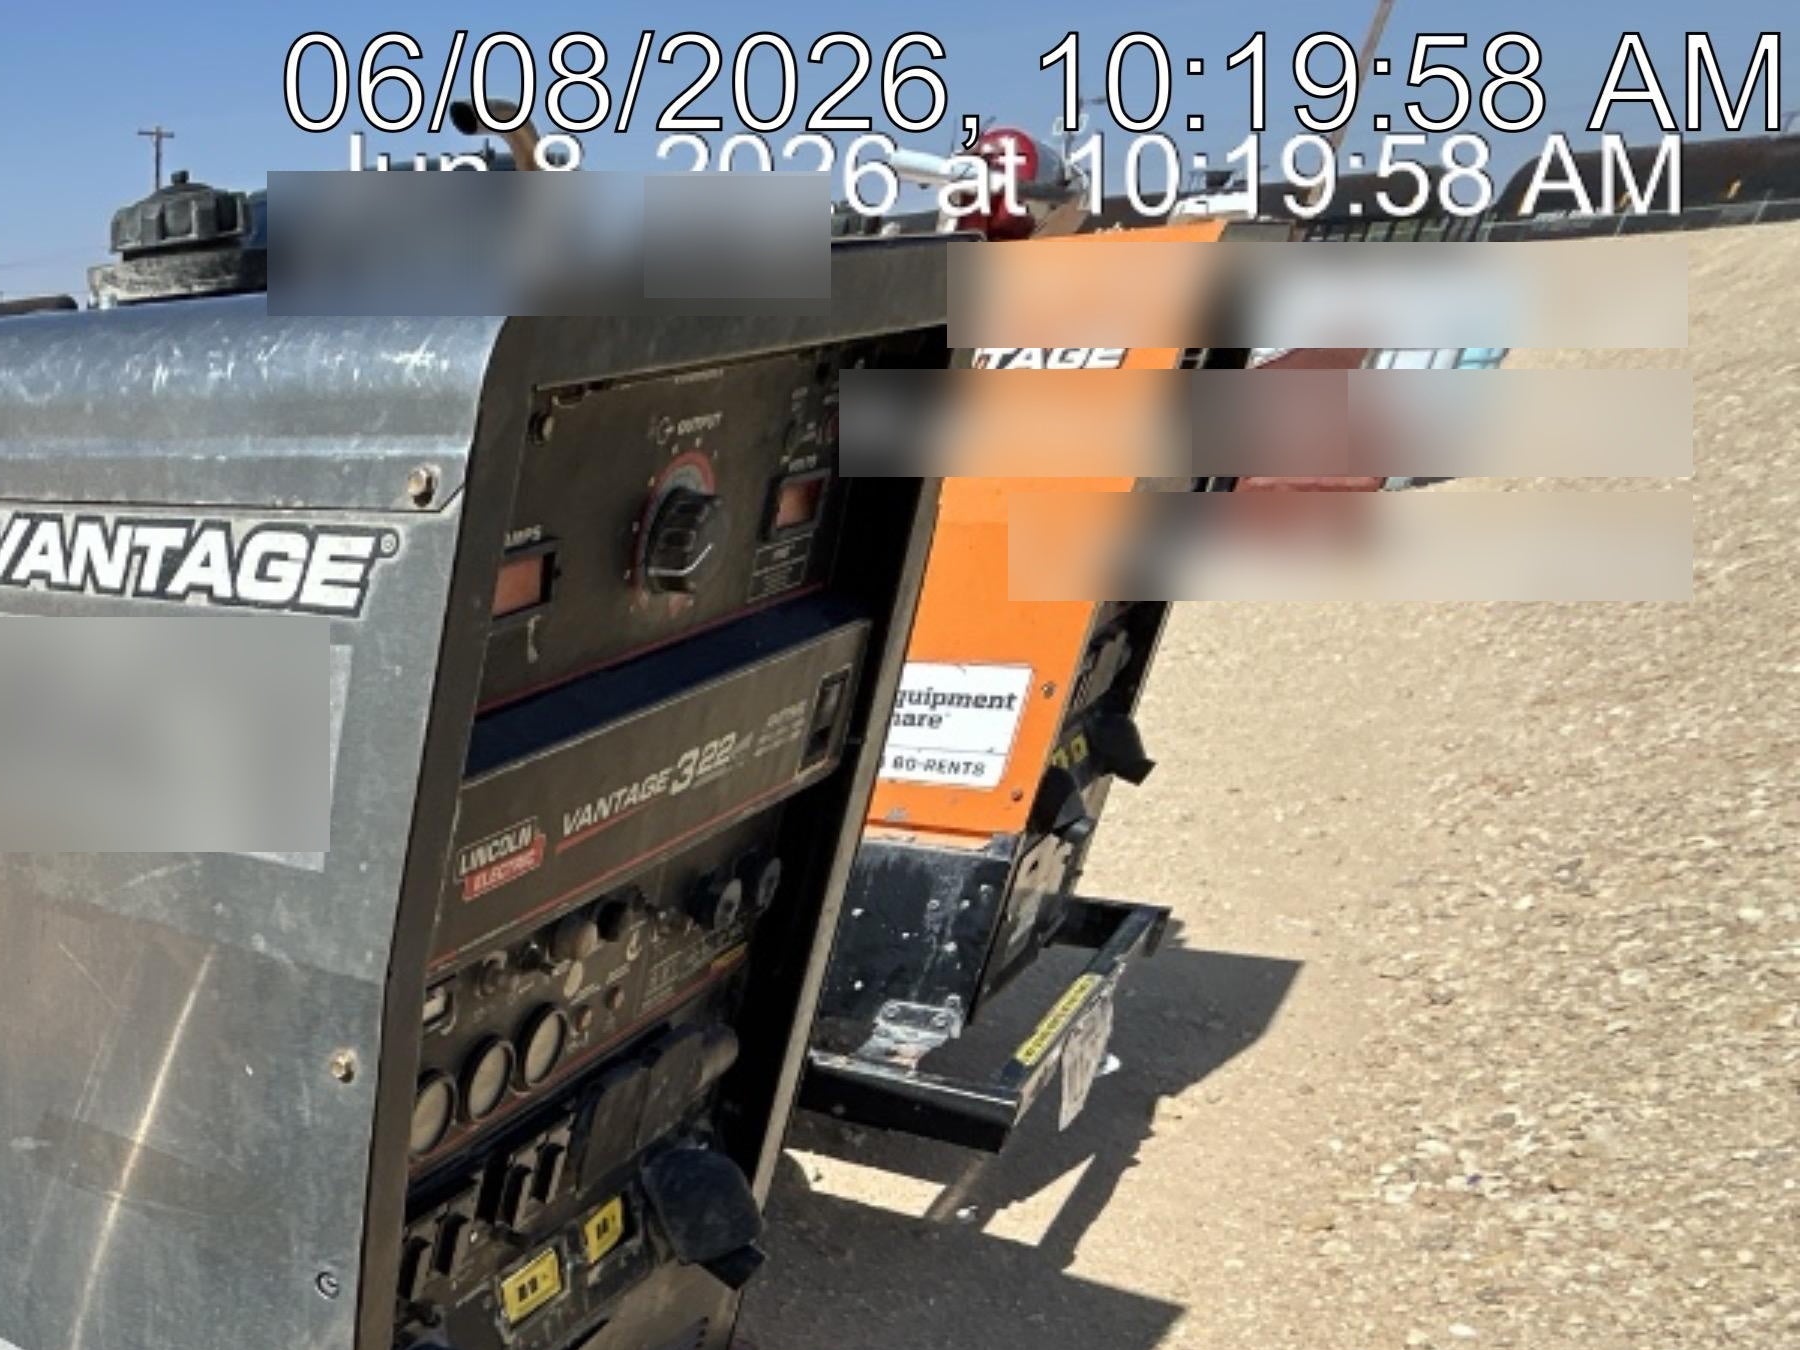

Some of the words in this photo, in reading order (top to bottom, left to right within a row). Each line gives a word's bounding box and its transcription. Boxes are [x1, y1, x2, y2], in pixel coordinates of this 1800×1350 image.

[562, 771, 671, 836] VANTAGE
[669, 731, 736, 796] 322
[458, 823, 534, 875] LINCOLN
